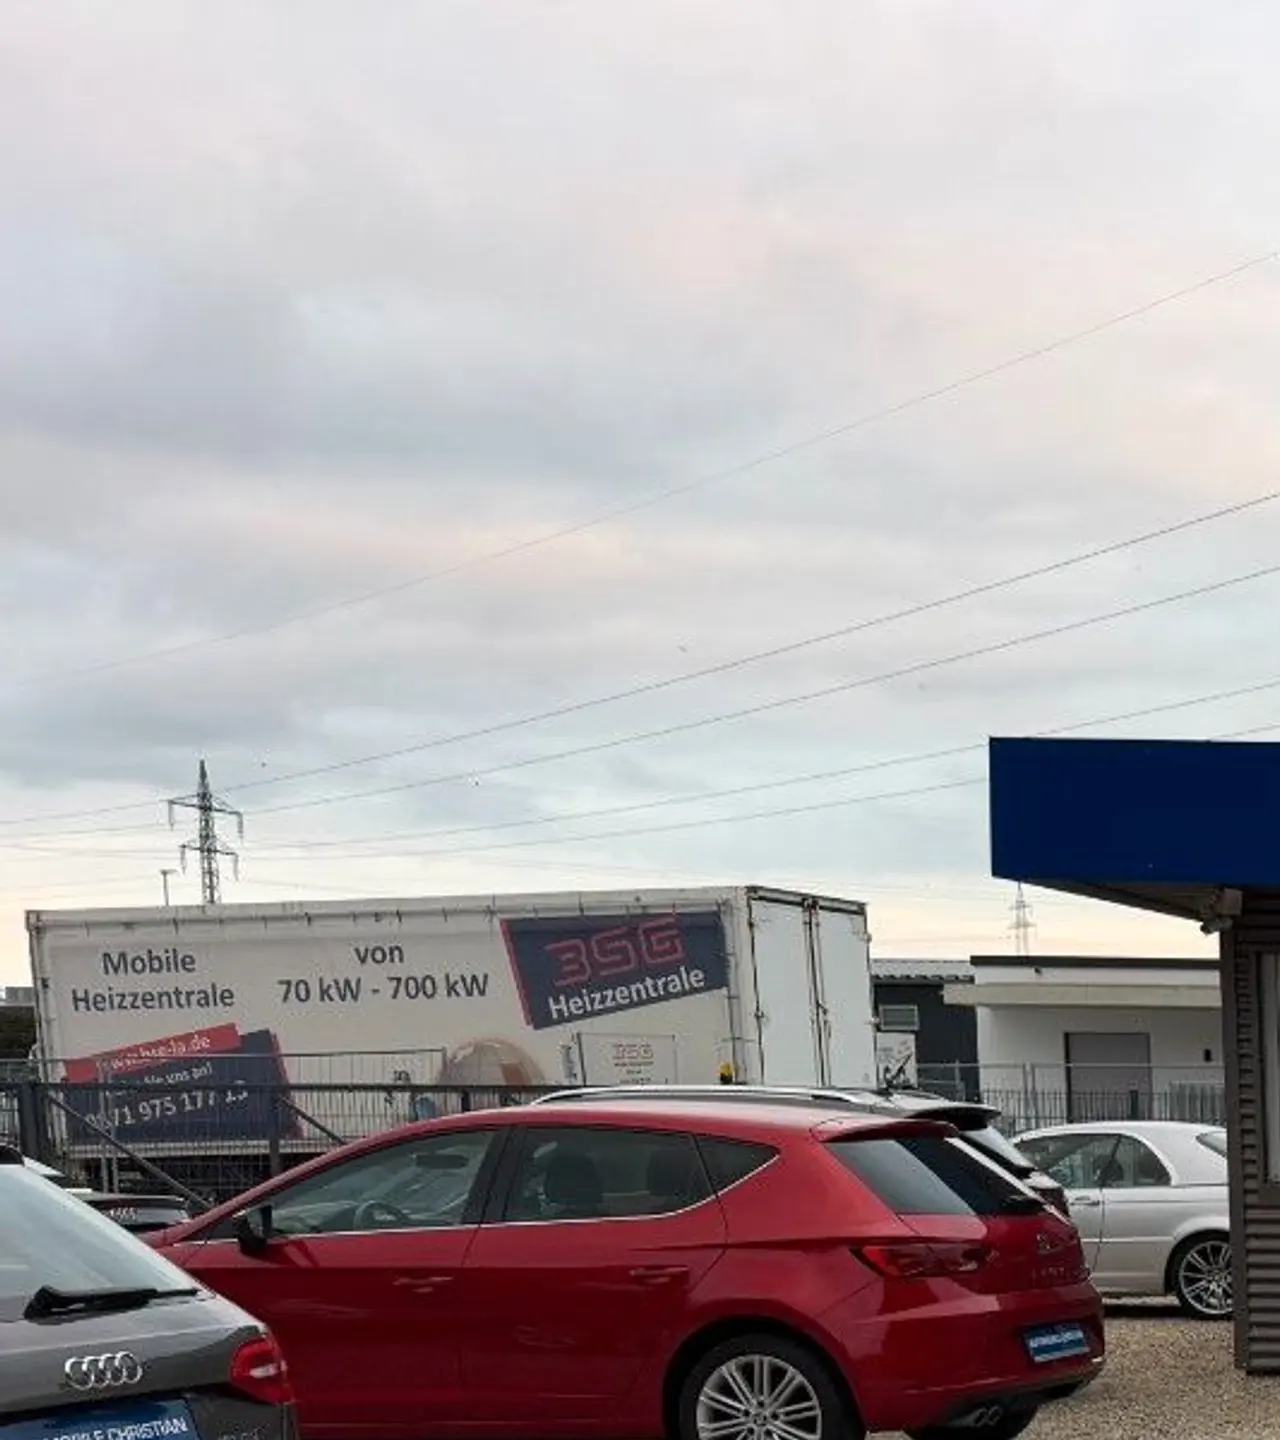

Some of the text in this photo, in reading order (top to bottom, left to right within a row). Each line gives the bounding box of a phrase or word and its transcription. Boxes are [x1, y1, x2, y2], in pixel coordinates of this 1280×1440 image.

[102, 949, 197, 976] Mobile
[353, 945, 404, 965] von
[72, 982, 235, 1013] Heizzentrale
[278, 978, 311, 1003] 70
[319, 976, 361, 1002] kW
[387, 974, 437, 999] 700
[445, 972, 489, 998] kW
[548, 966, 705, 1019] Heizzentrale
[139, 1096, 177, 1121] 975
